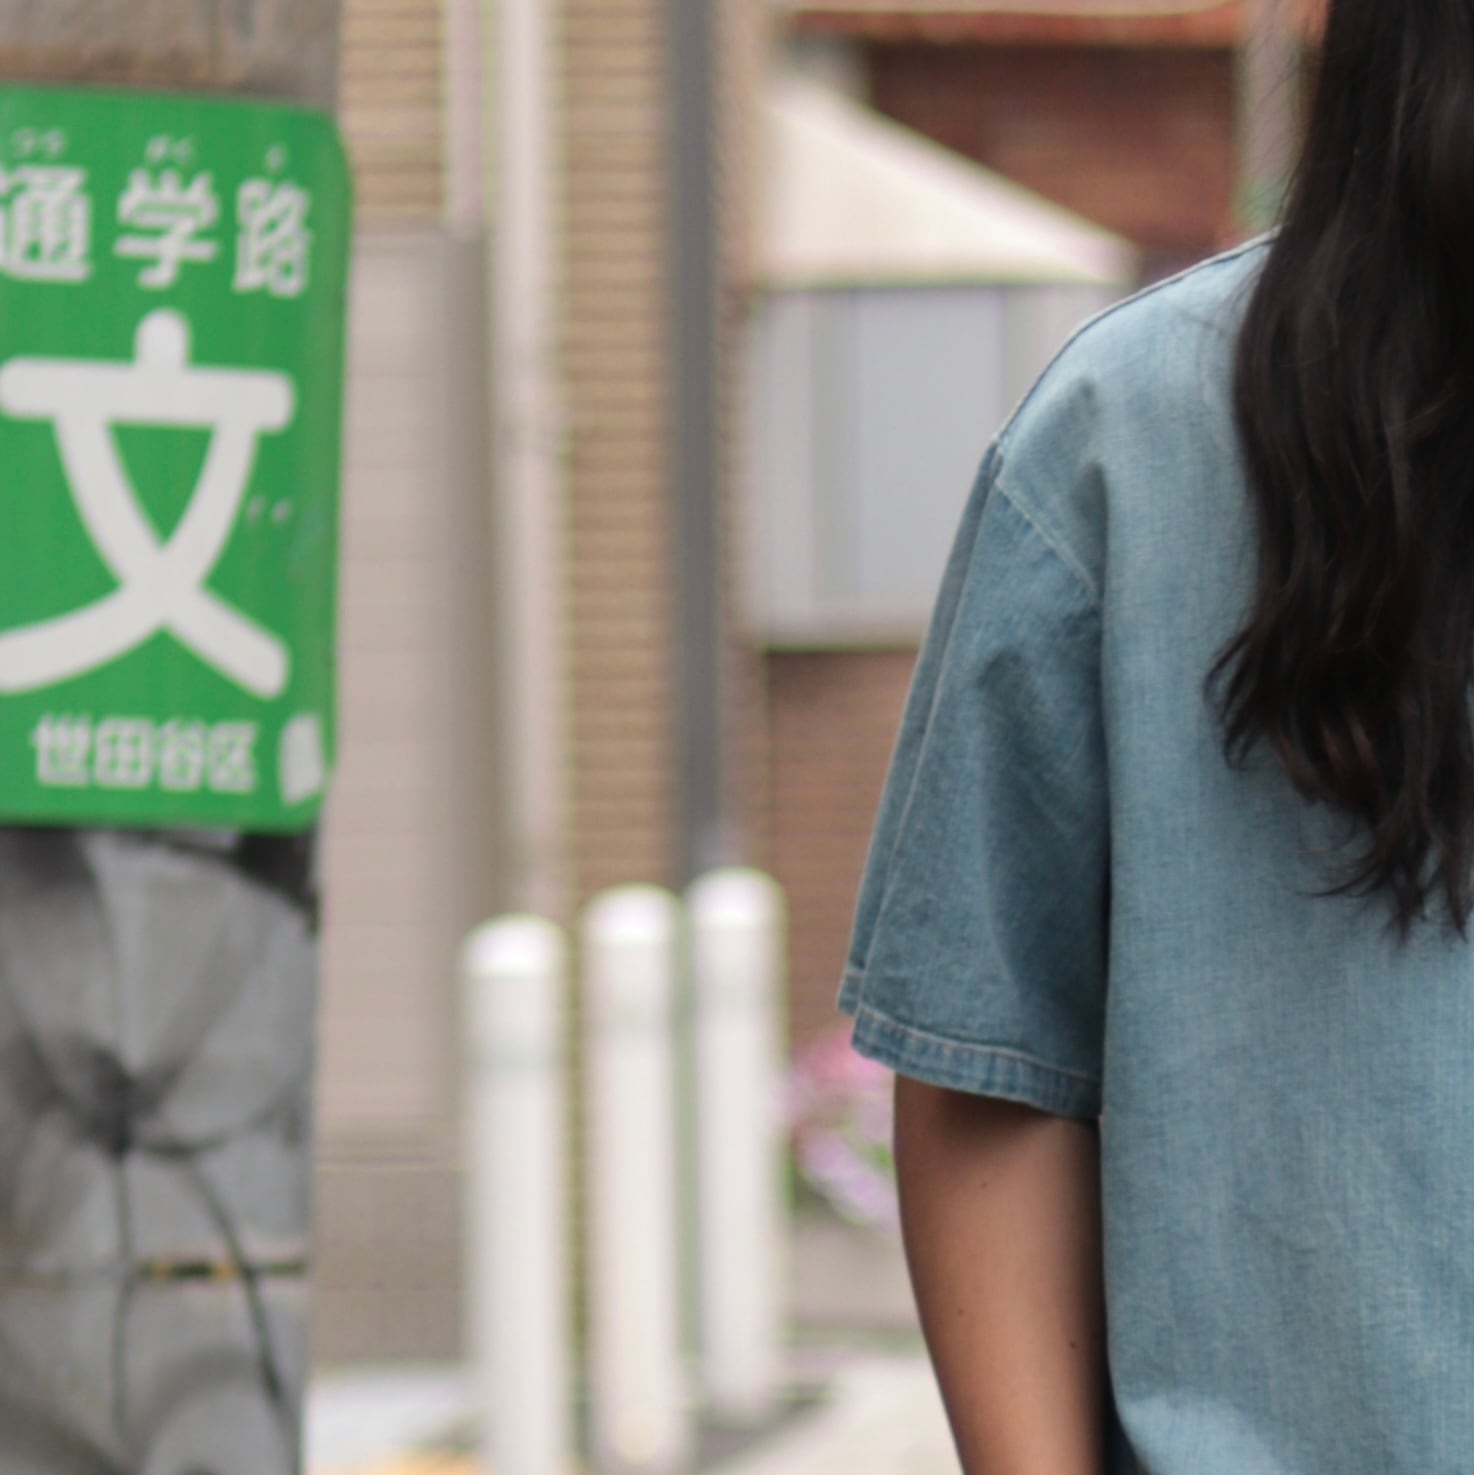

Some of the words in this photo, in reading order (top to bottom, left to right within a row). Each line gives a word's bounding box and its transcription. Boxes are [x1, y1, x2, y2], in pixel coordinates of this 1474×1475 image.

[0, 164, 310, 297] 通学路
[0, 307, 294, 700] 文
[30, 713, 257, 793] 世田谷区
